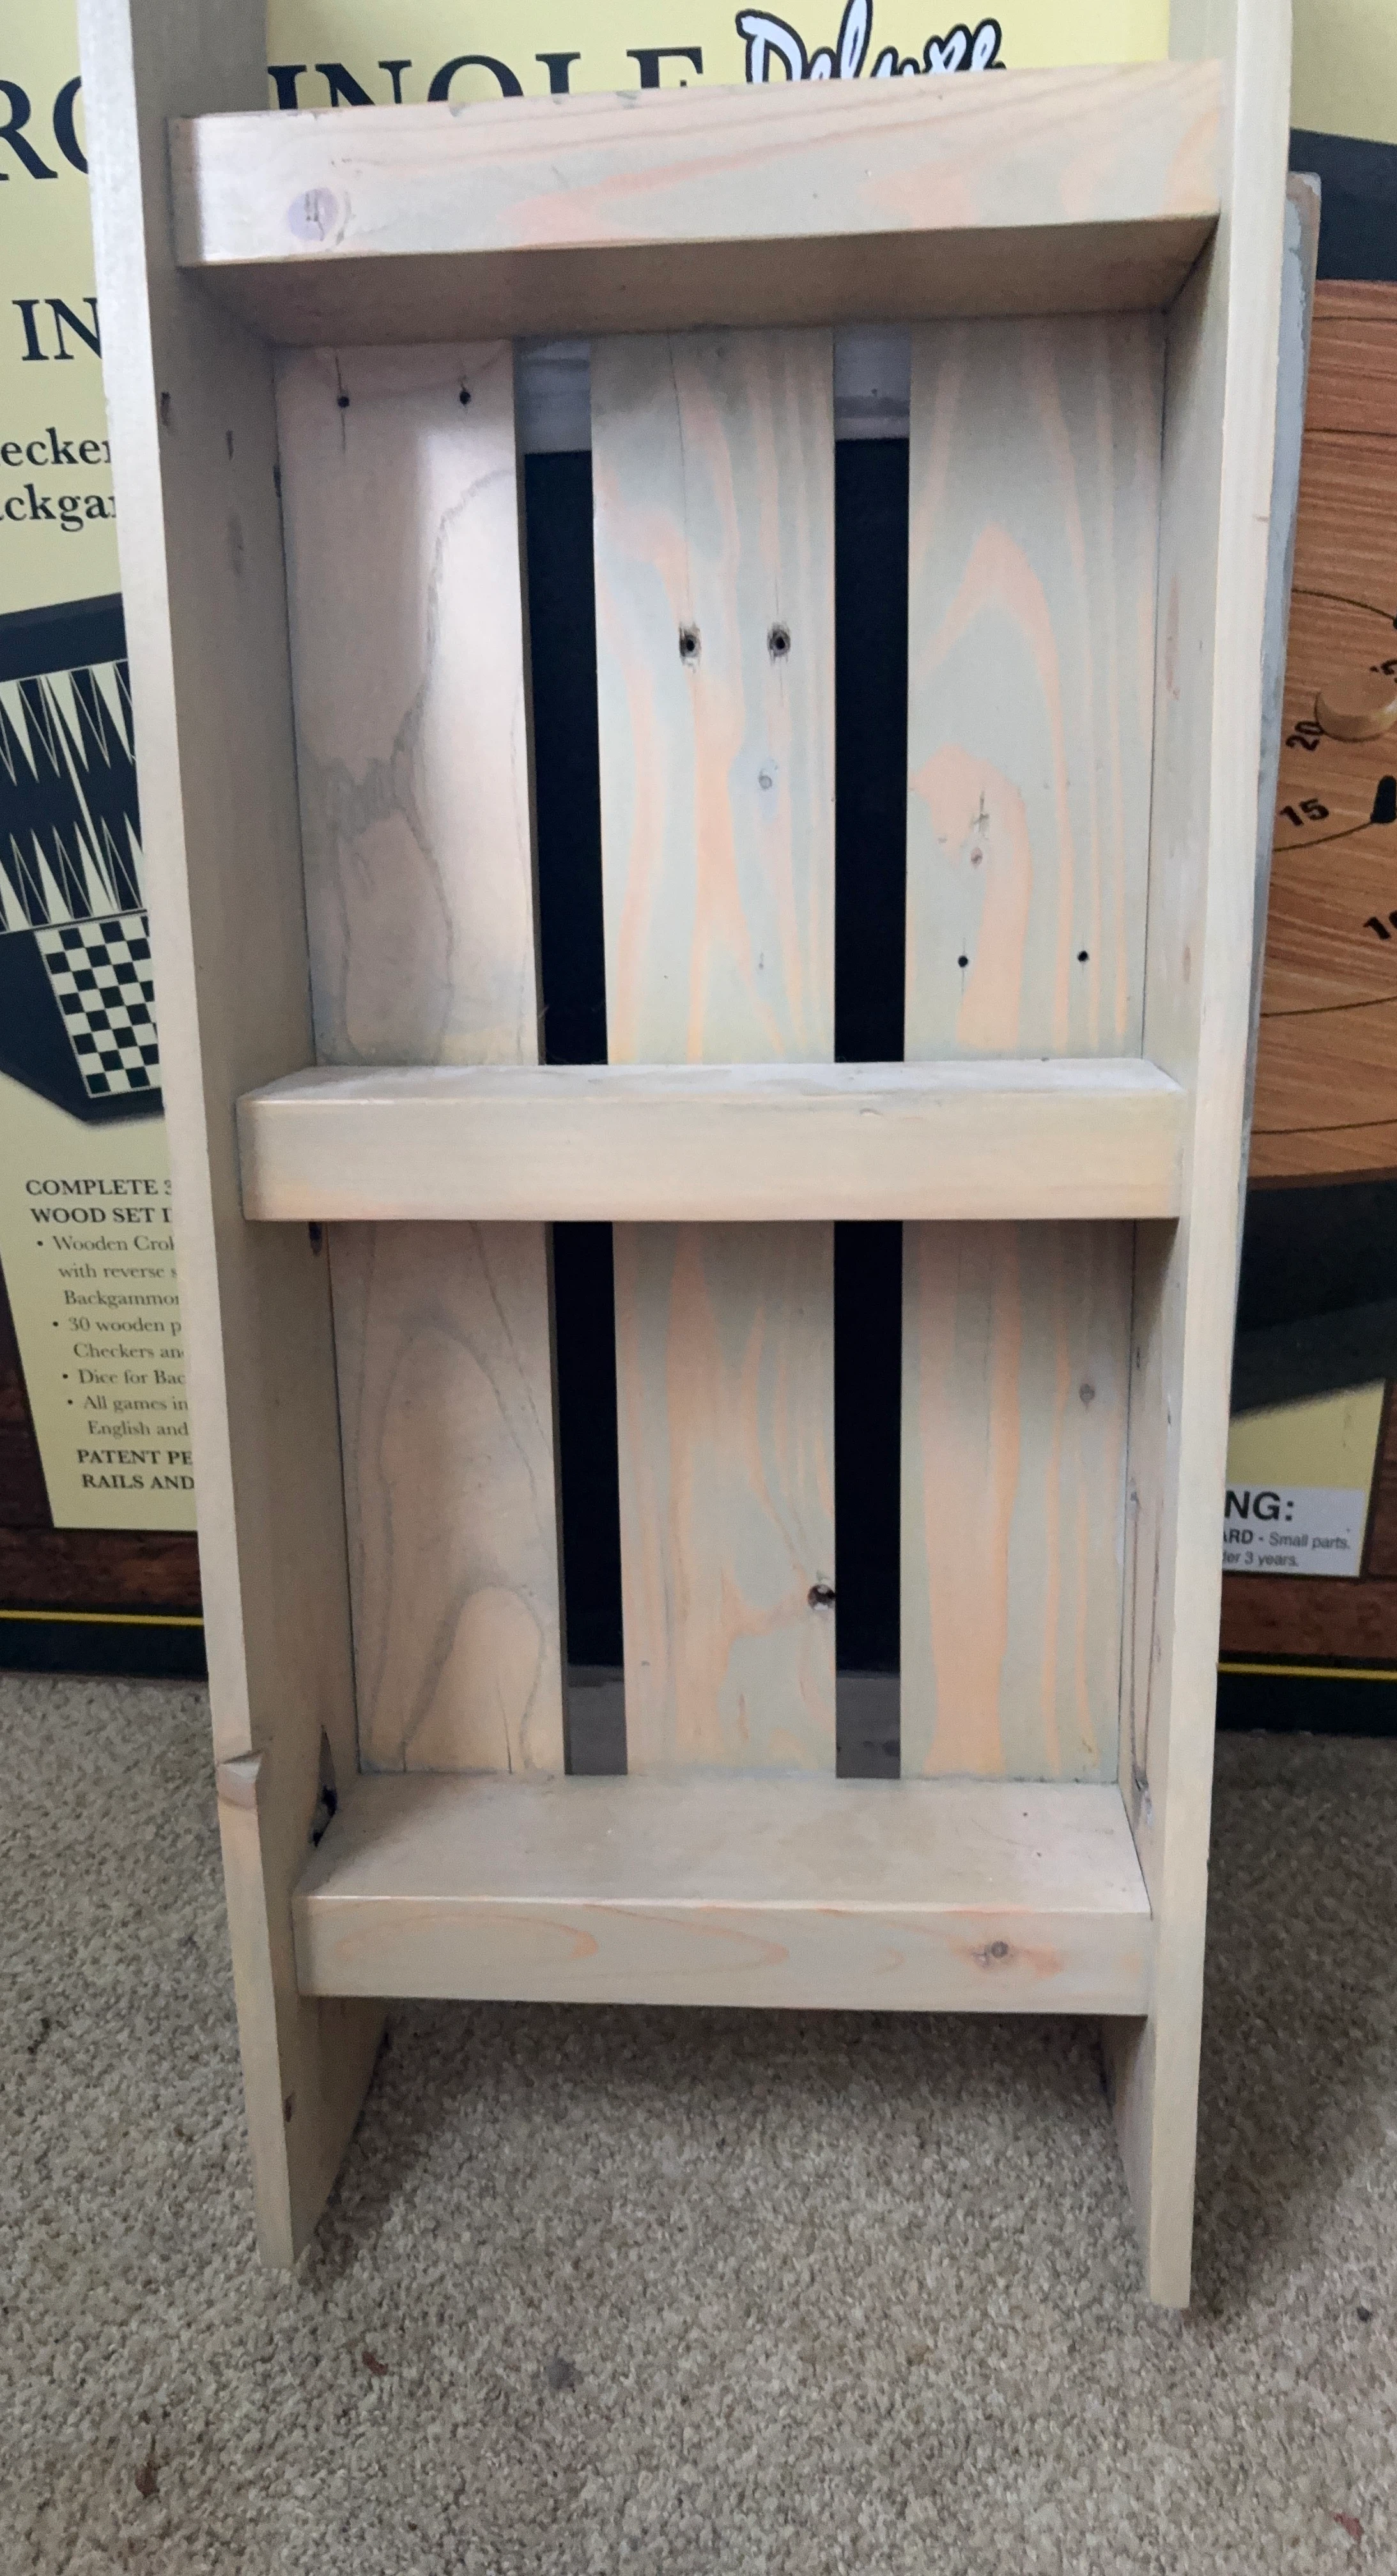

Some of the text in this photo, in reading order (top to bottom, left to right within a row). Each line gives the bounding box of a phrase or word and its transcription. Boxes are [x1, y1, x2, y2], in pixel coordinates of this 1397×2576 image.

[1285, 719, 1324, 751] 20
[1279, 798, 1329, 826] 15
[26, 1179, 158, 1195] COMPLETE
[31, 1208, 106, 1223] WOOD
[112, 1208, 155, 1223] SET
[52, 1235, 128, 1251] Wooden
[58, 1263, 96, 1278] with
[103, 1268, 164, 1278] reverse
[68, 1316, 90, 1332] 30
[96, 1317, 164, 1332] wooden
[73, 1343, 154, 1358] Checkers
[78, 1368, 118, 1384] Dice
[124, 1369, 148, 1384] for
[84, 1395, 107, 1410] All
[113, 1399, 167, 1413] games
[88, 1420, 189, 1438] English and
[77, 1449, 160, 1465] PATENT
[82, 1473, 194, 1489] RAILS AND
[1269, 1531, 1308, 1547] Small
[1312, 1535, 1351, 1550] parts.
[1244, 1551, 1253, 1565] 3
[1258, 1553, 1299, 1567] years.
